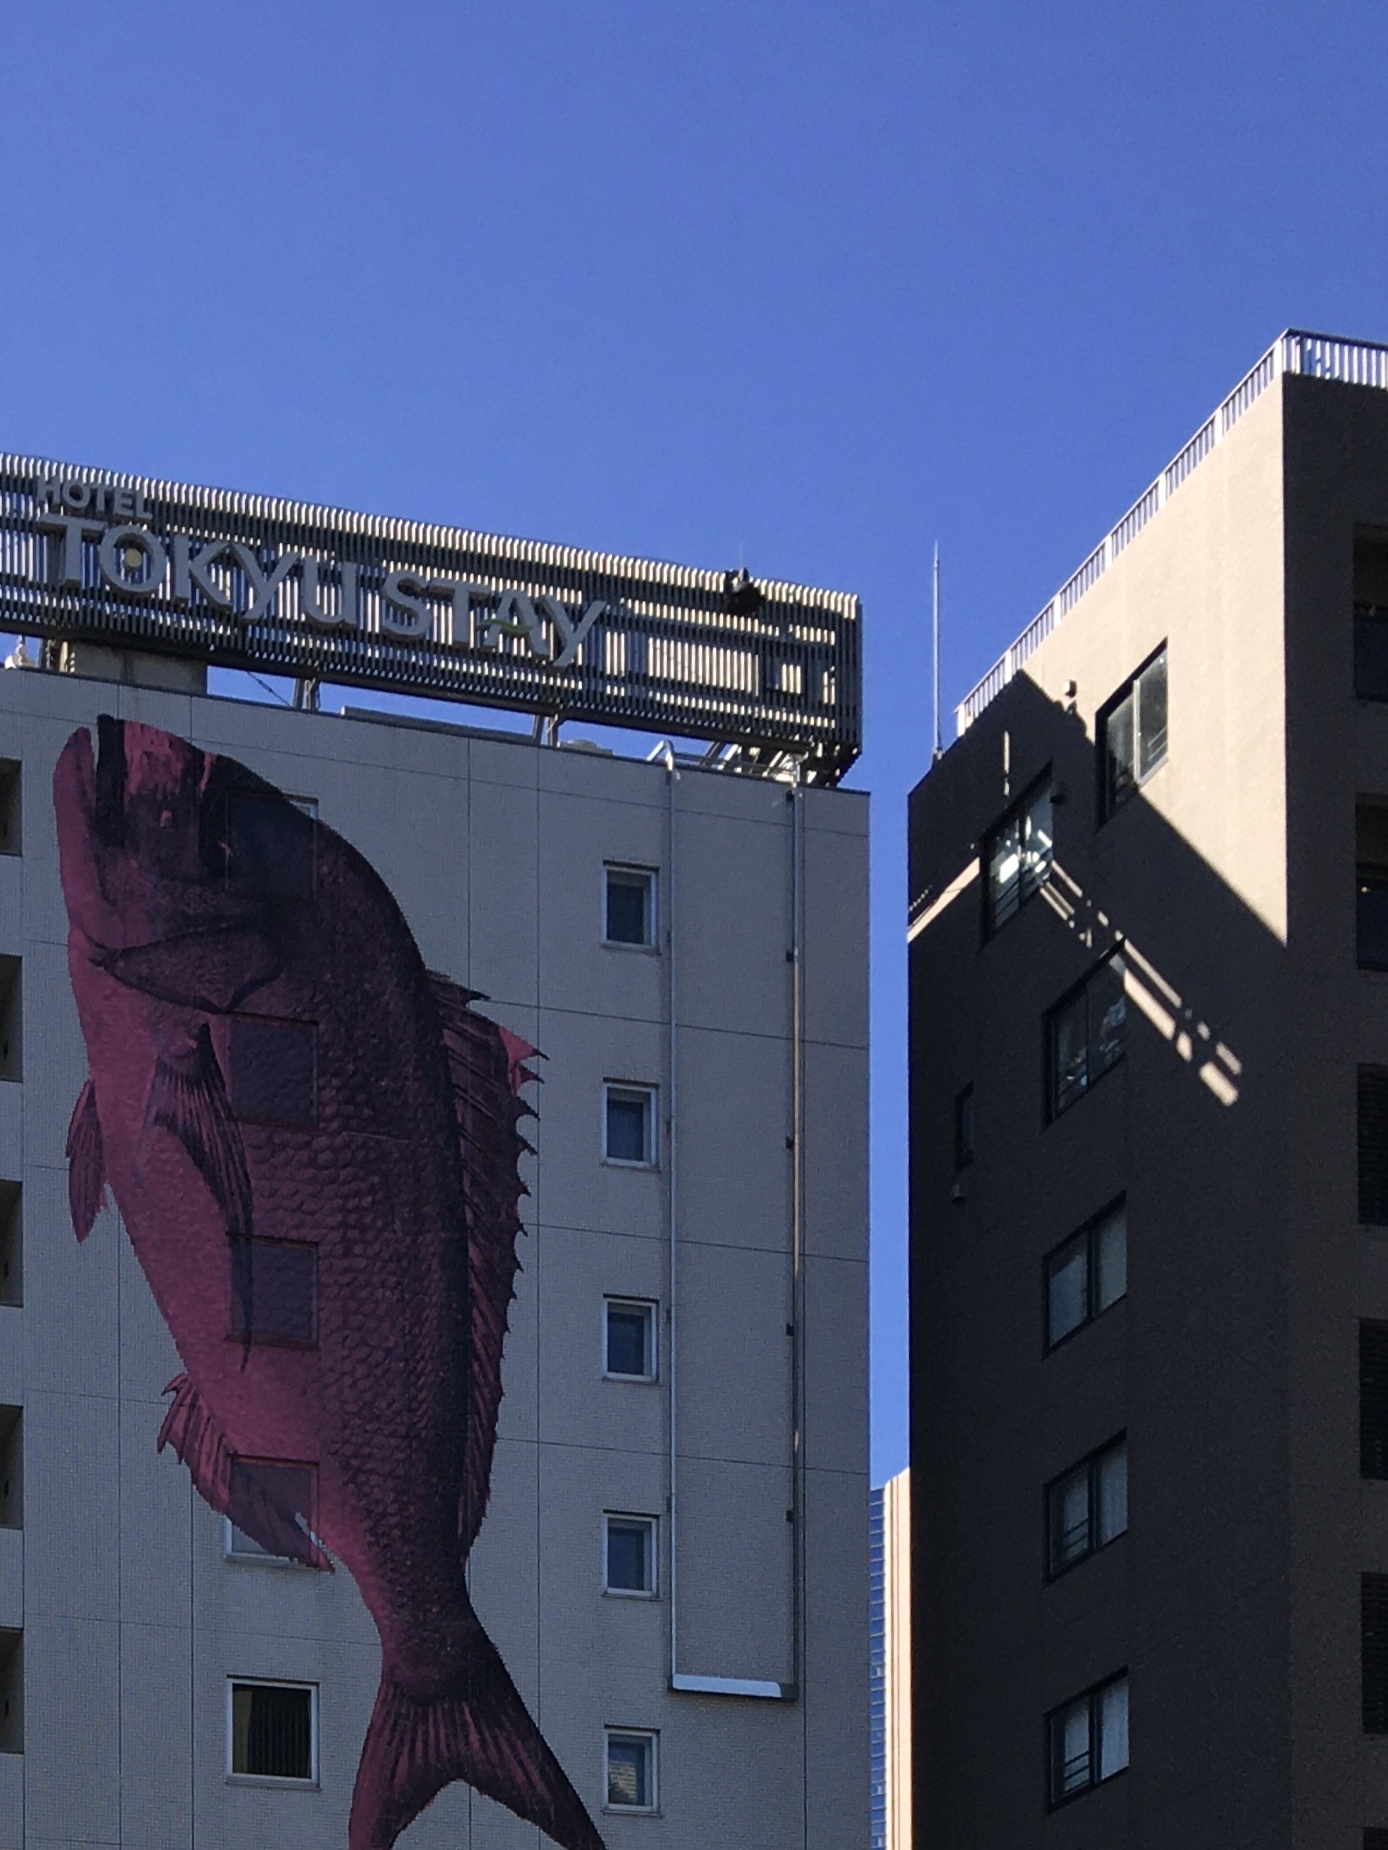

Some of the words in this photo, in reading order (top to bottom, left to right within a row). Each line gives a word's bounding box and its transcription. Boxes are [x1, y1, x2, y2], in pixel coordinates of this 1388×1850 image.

[37, 475, 154, 520] HOTEL
[36, 512, 356, 633] TOKYU
[382, 569, 610, 669] STAY
